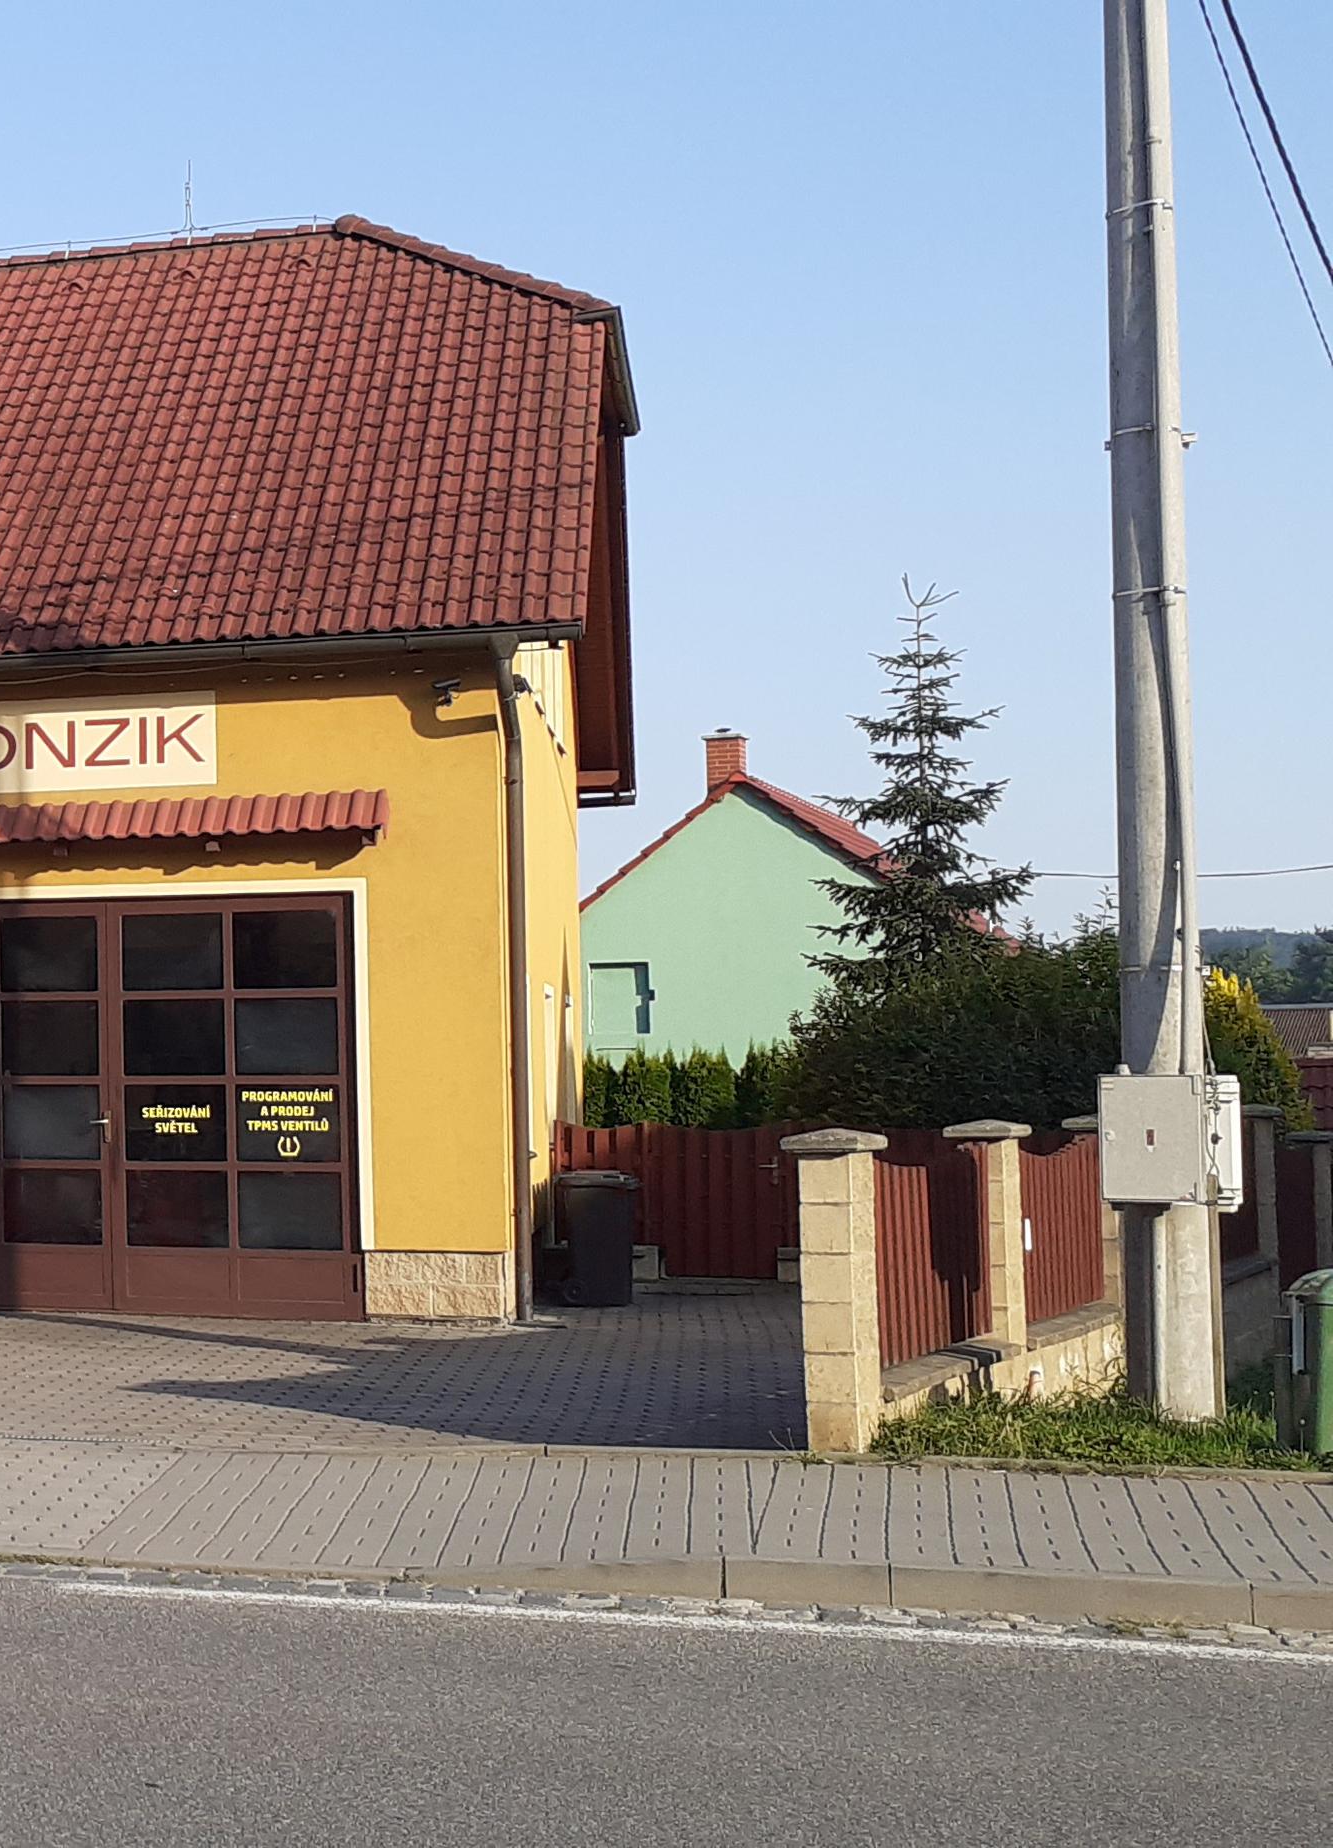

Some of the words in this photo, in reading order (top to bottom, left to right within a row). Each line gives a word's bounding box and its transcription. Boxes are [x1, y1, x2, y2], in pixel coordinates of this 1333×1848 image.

[241, 1088, 333, 1102] PROGRAMOVÁNÍ
[141, 1104, 211, 1118] SEŘIZOVÁNÍ
[260, 1106, 269, 1116] A
[271, 1106, 315, 1116] PRODEJ
[154, 1120, 198, 1133] SVĚTEL
[246, 1120, 278, 1131] TPMS
[280, 1118, 329, 1132] VENTILŮ
